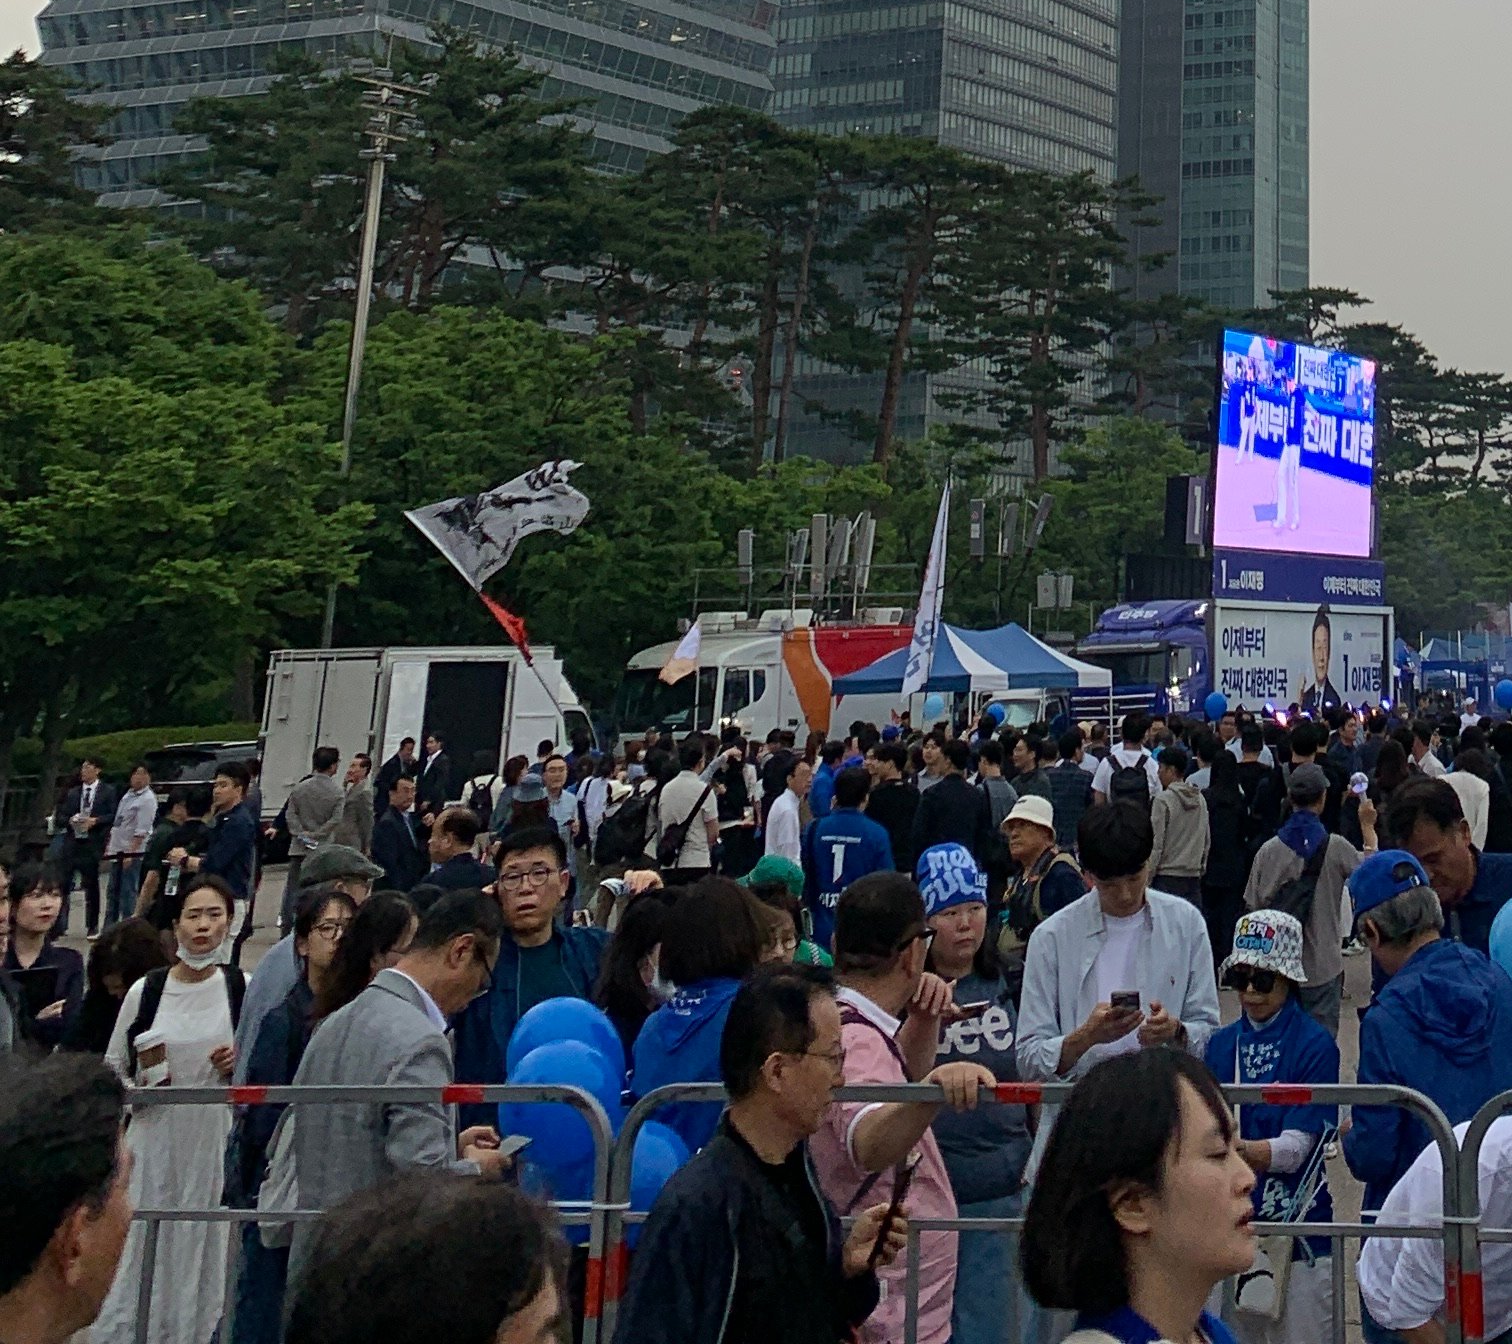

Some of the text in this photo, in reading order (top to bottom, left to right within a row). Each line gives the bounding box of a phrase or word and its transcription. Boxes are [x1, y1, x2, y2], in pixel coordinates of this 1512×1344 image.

[1303, 410, 1338, 458] 진짜
[1221, 559, 1228, 590] 1
[1222, 626, 1266, 658] 이제부터
[1221, 666, 1288, 699] 진짜 대한민국
[1343, 654, 1382, 693] 1 이재명
[832, 843, 846, 883] 1
